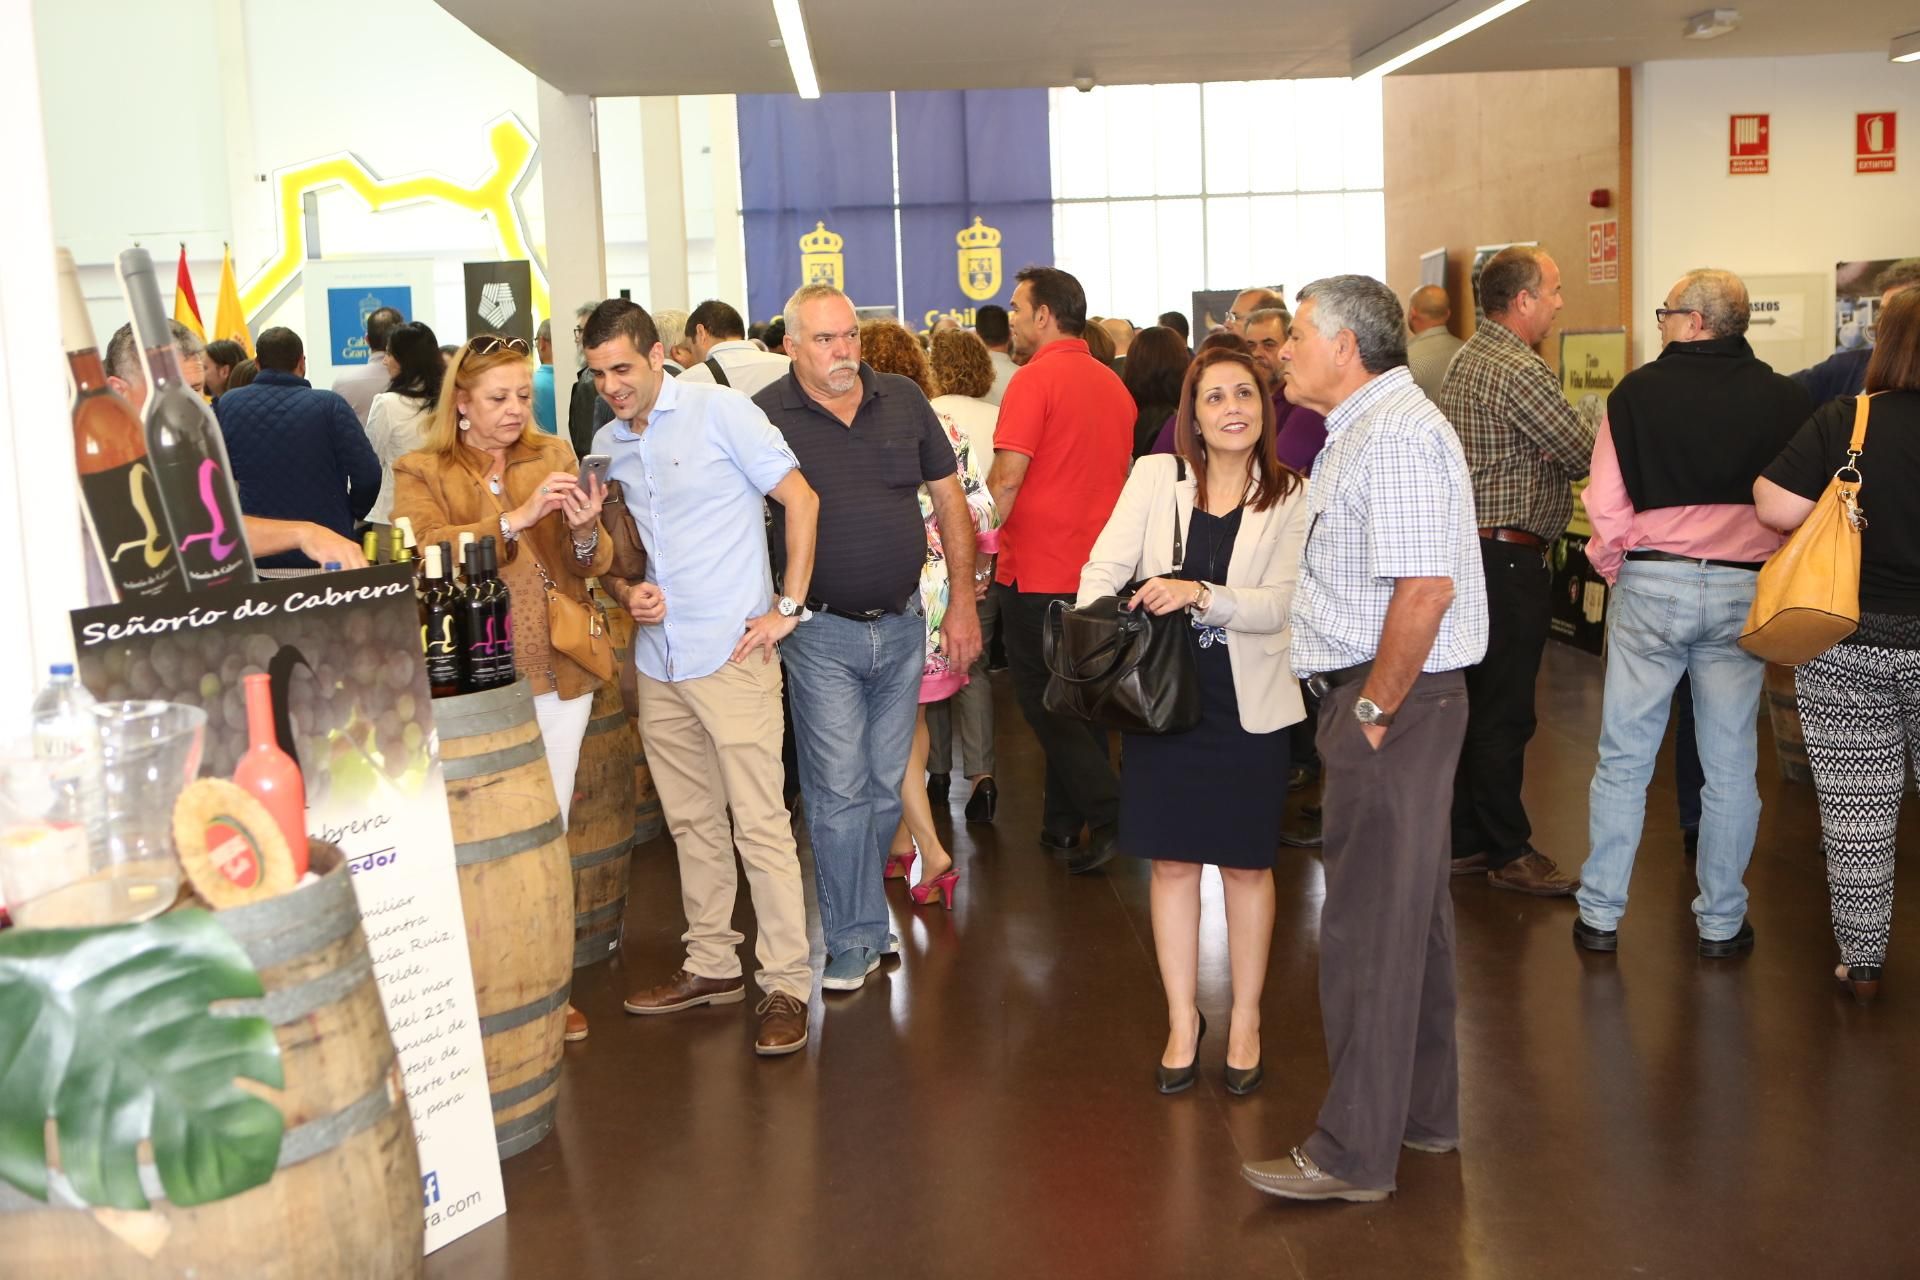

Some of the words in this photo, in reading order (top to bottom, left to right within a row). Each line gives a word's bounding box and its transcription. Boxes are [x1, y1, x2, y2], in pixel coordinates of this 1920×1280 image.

[82, 608, 226, 646] Señorío
[233, 598, 277, 621] de
[283, 581, 410, 613] Cabrera
[349, 852, 396, 875] edos
[361, 895, 415, 917] miliar
[366, 915, 429, 944] cuentra
[422, 977, 454, 996] mar
[403, 1055, 436, 1077] taje
[406, 1076, 447, 1099] ierte
[427, 1094, 465, 1118] para
[424, 1191, 482, 1231] ra.com
